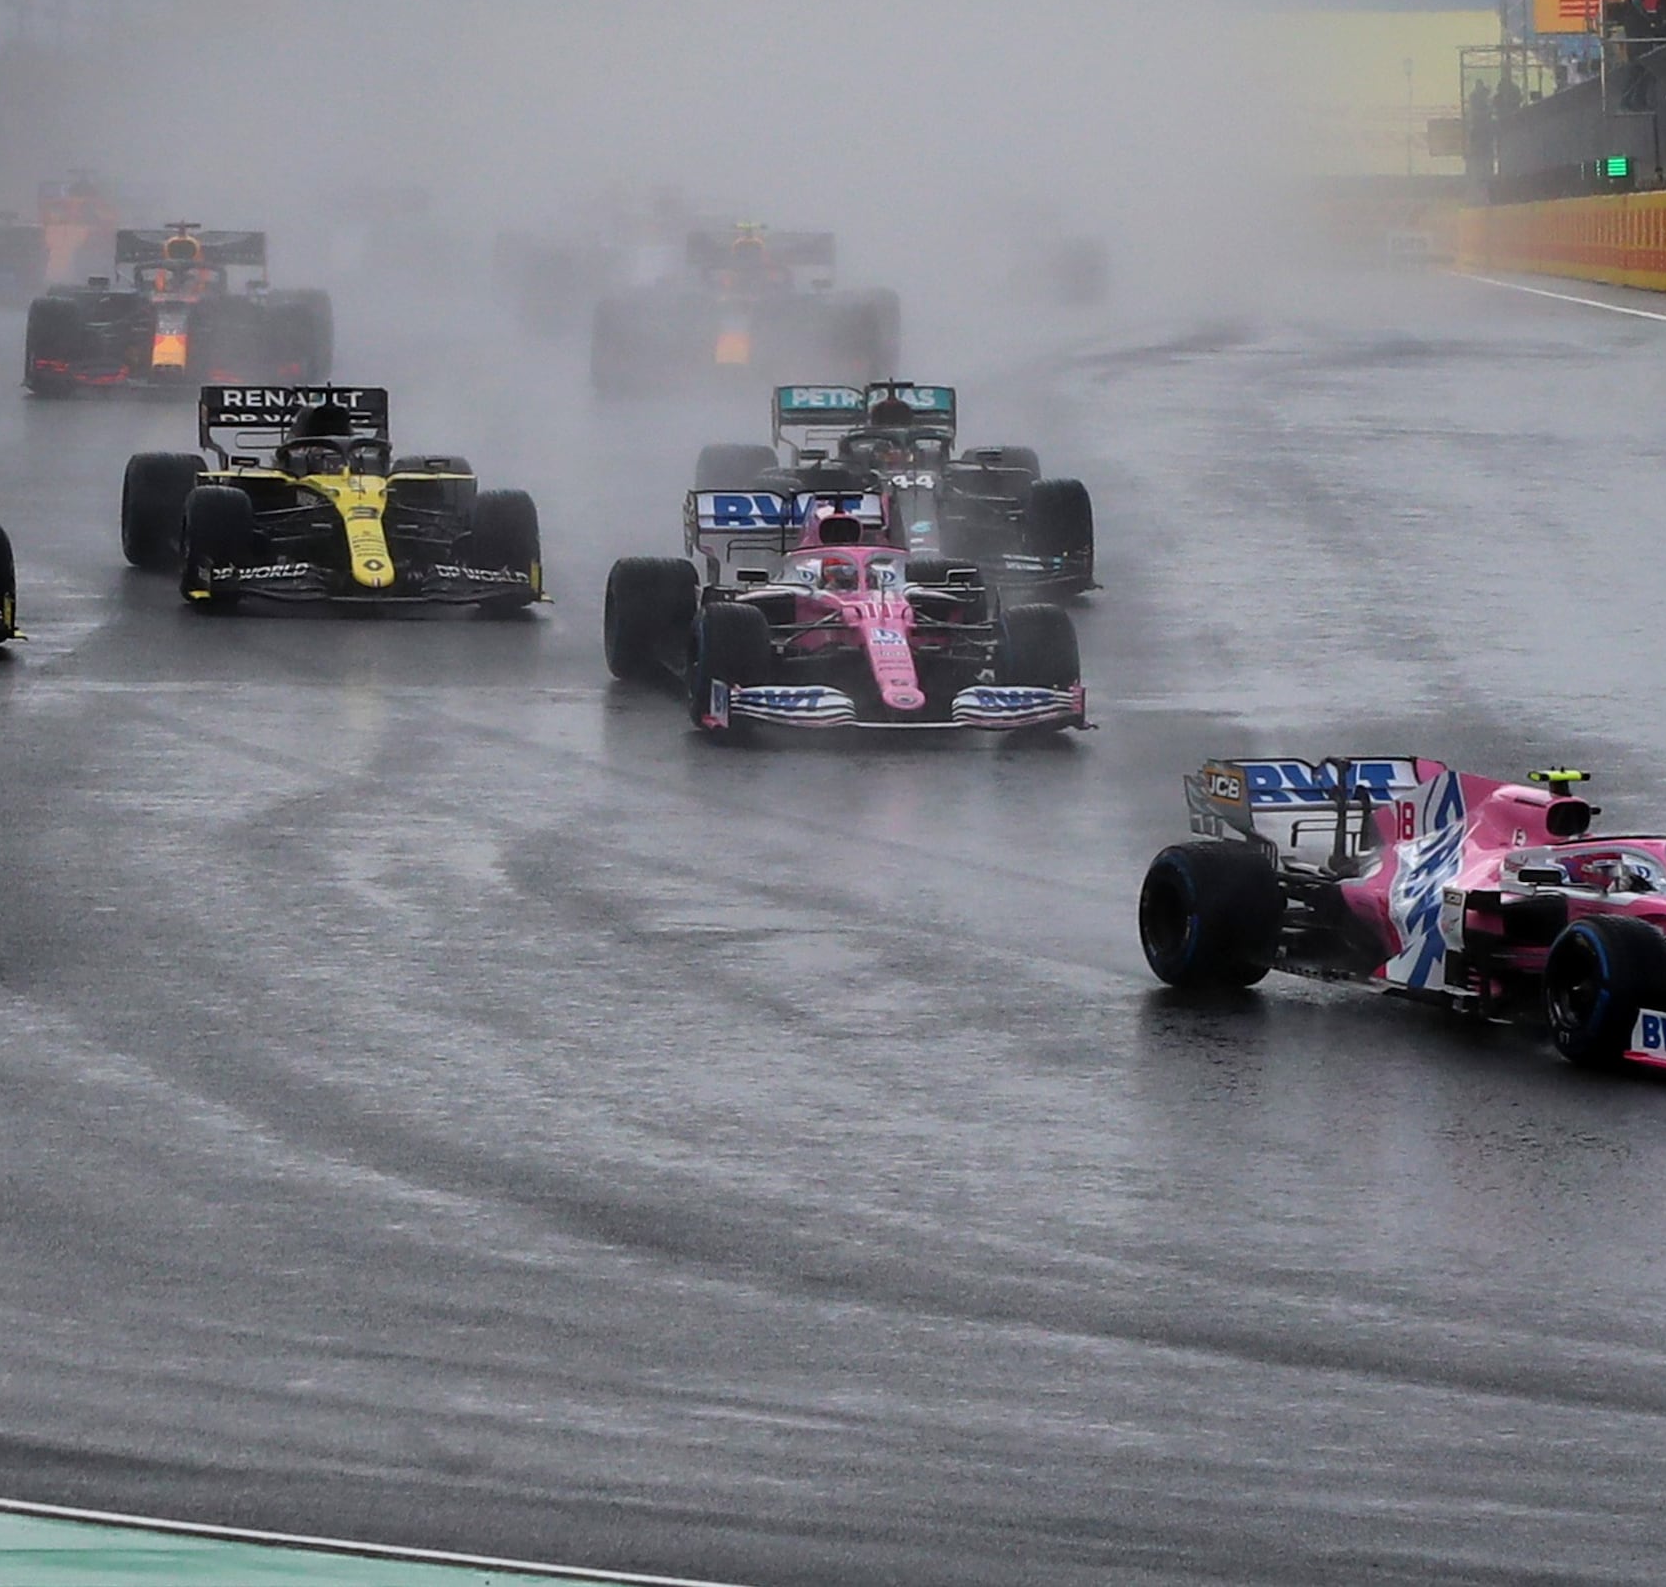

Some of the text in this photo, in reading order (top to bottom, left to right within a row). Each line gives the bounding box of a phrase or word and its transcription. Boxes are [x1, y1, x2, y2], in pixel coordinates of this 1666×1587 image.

[891, 474, 935, 489] 44
[1208, 773, 1241, 799] JCB
[1243, 762, 1399, 804] BWT
[1395, 801, 1416, 841] 18
